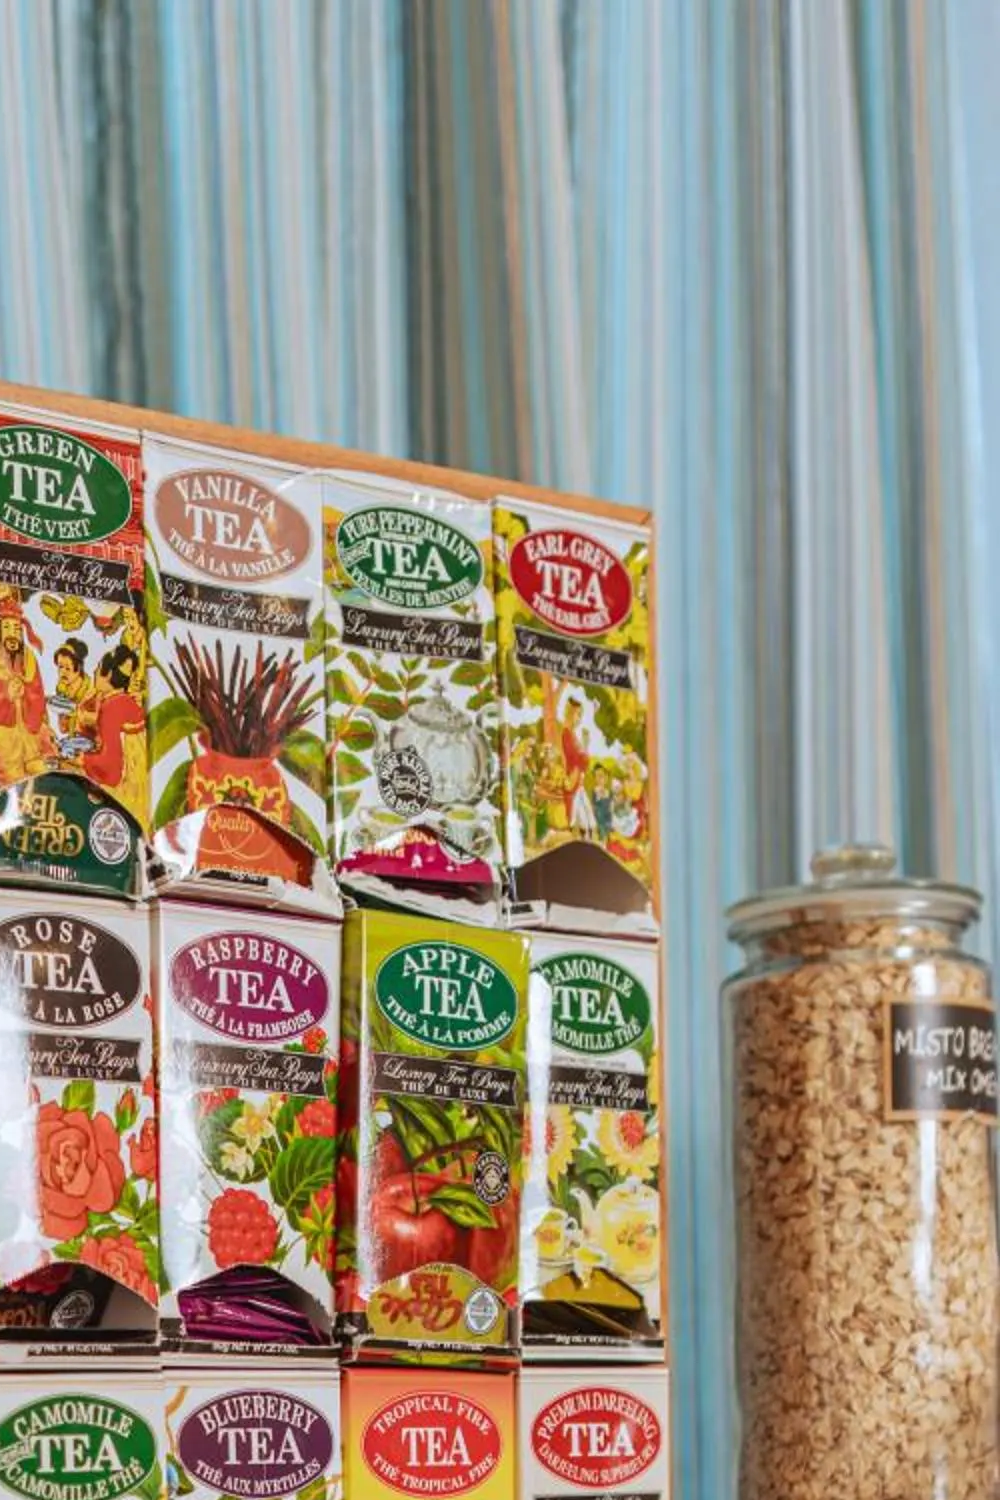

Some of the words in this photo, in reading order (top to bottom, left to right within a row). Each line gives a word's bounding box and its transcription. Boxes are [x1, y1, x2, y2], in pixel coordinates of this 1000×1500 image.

[2, 460, 96, 515] TEA
[174, 475, 276, 520] VANILLA
[3, 503, 42, 536] THÉ
[44, 517, 91, 539] VERT
[185, 504, 276, 555] TEA
[343, 511, 379, 543] PURE
[379, 511, 479, 567] PEPPERMINT
[41, 551, 79, 581] Tea
[78, 559, 127, 597] Bags
[210, 557, 229, 577] LA
[230, 548, 296, 577] VANILLE
[365, 536, 452, 583] TEA
[523, 534, 568, 563] EARL
[570, 536, 615, 577] GREY
[162, 578, 227, 616] Luxury
[221, 592, 258, 617] Tea
[257, 598, 304, 631] Bags
[406, 591, 425, 607] DE
[535, 559, 607, 614] TEA
[345, 609, 406, 643] Luxury
[402, 616, 436, 643] Tea
[10, 918, 97, 954] ROSE
[13, 950, 107, 995] TEA
[189, 937, 319, 987] RASPBERRY
[402, 948, 496, 990] APPLE
[541, 959, 635, 998] CAMOMILE
[55, 1007, 77, 1024] LA
[82, 991, 125, 1021] ROSE
[209, 967, 295, 1013] TEA
[414, 974, 488, 1023] TEA
[551, 985, 627, 1029] TEA
[228, 1018, 245, 1035] LA
[247, 1009, 315, 1038] FRAMBOISE
[431, 1026, 454, 1043] LA
[457, 1010, 512, 1043] POMME
[56, 1037, 90, 1067] Tea
[91, 1041, 137, 1074] Bags
[279, 1056, 321, 1090] Bags
[382, 1057, 437, 1087] Luxury
[439, 1065, 468, 1085] Tea
[470, 1071, 510, 1096] Bags
[434, 1084, 451, 1095] DE
[459, 1088, 489, 1100] LUXE
[13, 1401, 133, 1438] CAMOMILE
[198, 1394, 319, 1435] BLUEBERRY
[373, 1396, 453, 1435] TROPICAL
[456, 1400, 492, 1436] FIRE
[537, 1391, 591, 1440] PREMIUM
[592, 1391, 657, 1440] DARJEELING
[30, 1433, 123, 1474] TEA
[217, 1427, 305, 1465] TEA
[401, 1426, 472, 1468] TEA
[563, 1422, 636, 1457] TEA
[224, 1477, 251, 1492] AUX
[254, 1459, 321, 1494] MYRTILLES
[402, 1473, 468, 1493] TROPICAL
[468, 1453, 497, 1482] FIRE
